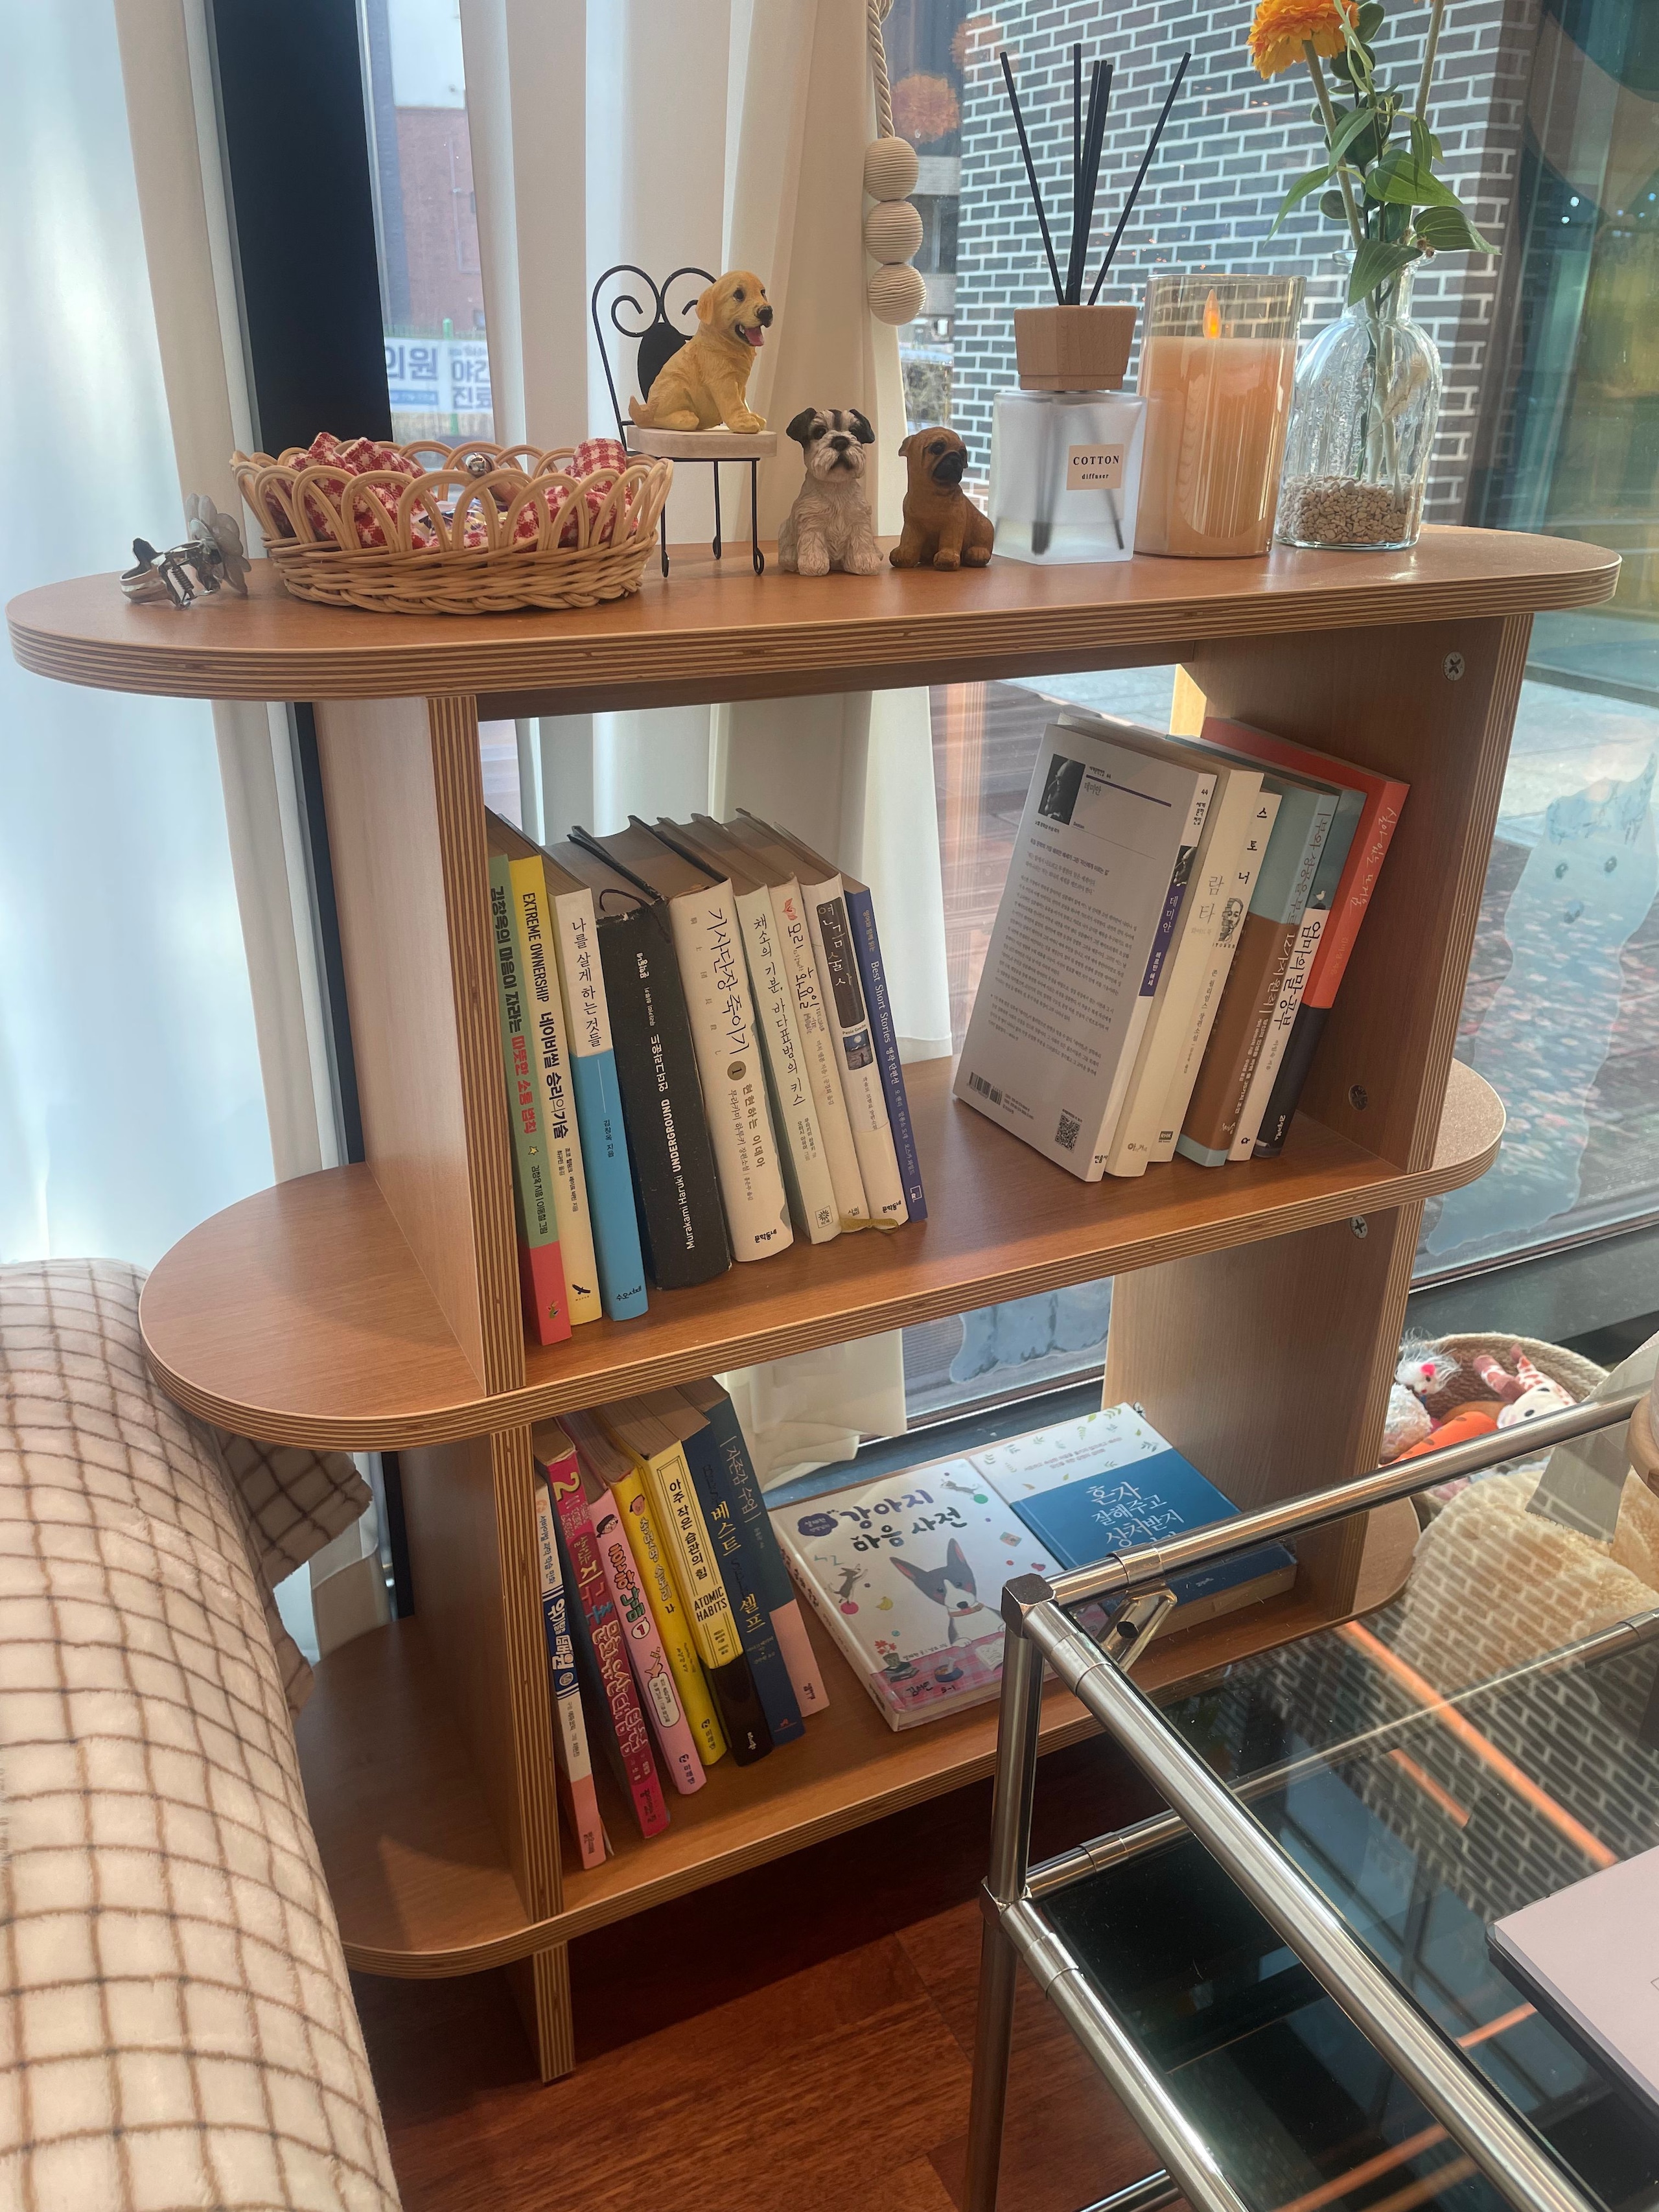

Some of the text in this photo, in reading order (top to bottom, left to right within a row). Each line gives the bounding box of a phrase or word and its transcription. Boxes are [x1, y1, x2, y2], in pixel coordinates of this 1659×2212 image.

[1073, 455, 1120, 466] COTTON
[1084, 782, 1102, 796] 데미안
[1238, 807, 1268, 885] 스토너
[862, 909, 872, 927] 영어와
[1163, 896, 1178, 933] 데미안
[1200, 875, 1225, 924] 람타
[1262, 818, 1327, 1006] 부와 성공을 12가지 원칙
[522, 892, 550, 1002] EXTREME OWNERSHIP
[818, 903, 853, 986] 연금술사
[1153, 952, 1162, 971] 헤르만
[1289, 921, 1321, 970] 엄마의
[572, 918, 602, 1047] 나를 살게 하는 것들
[634, 951, 655, 1026] 무라카미 하루키 문학동네
[707, 908, 749, 1054] 기사단장 죽이기
[795, 967, 819, 1009] 화요일
[488, 885, 538, 1134] 김창옥의 마음이 자라는 따뜻한 소통 법칙
[754, 914, 772, 957] 채소의
[772, 999, 798, 1074] 바다표범의
[791, 1078, 806, 1106] 키스
[870, 960, 890, 1043] Best Short Stories
[1273, 974, 1303, 1030] 말공부
[539, 1012, 559, 1068] 네이비씰
[651, 1034, 668, 1091] 언더그라운드
[885, 1047, 899, 1084] 명작 단편선
[728, 1089, 741, 1121] 무라카미
[894, 1095, 903, 1106] 헨리
[734, 1122, 746, 1145] 하루키
[742, 1083, 765, 1167] 현현하는 이데아
[607, 1143, 614, 1158] 지음
[738, 1147, 750, 1171] 장편소설
[903, 1143, 912, 1159] 오스카
[906, 1159, 916, 1175] 와일드
[530, 1165, 542, 1184] 김창옥
[533, 1184, 543, 1197] 지음
[660, 1099, 695, 1249] Murakami Haruki UNDERGROUND
[848, 1206, 860, 1216] 살림
[882, 1200, 901, 1213] 문학동네
[539, 1222, 548, 1235] 그림
[754, 1229, 777, 1243] 문학동네
[616, 1285, 642, 1301] 수오서재
[552, 1471, 581, 1502] 2
[726, 1445, 758, 1514] 자존감 수업
[1086, 1482, 1142, 1506] 혼자
[710, 1500, 741, 1557] 베스트
[840, 1489, 934, 1530] 강아지
[1091, 1495, 1167, 1526] 잘해주고
[1106, 1509, 1185, 1548] 상처받지
[669, 1479, 708, 1580] 아주 작은 습관의 힘
[852, 1507, 968, 1552] 마음 사전
[607, 1543, 645, 1622] 흔한남매
[694, 1587, 724, 1611] ATOMIC
[636, 1624, 645, 1635] 1
[696, 1598, 727, 1622] HABITS
[739, 1593, 766, 1633] 셀프
[548, 1598, 575, 1670] 위기탈출 넘버원
